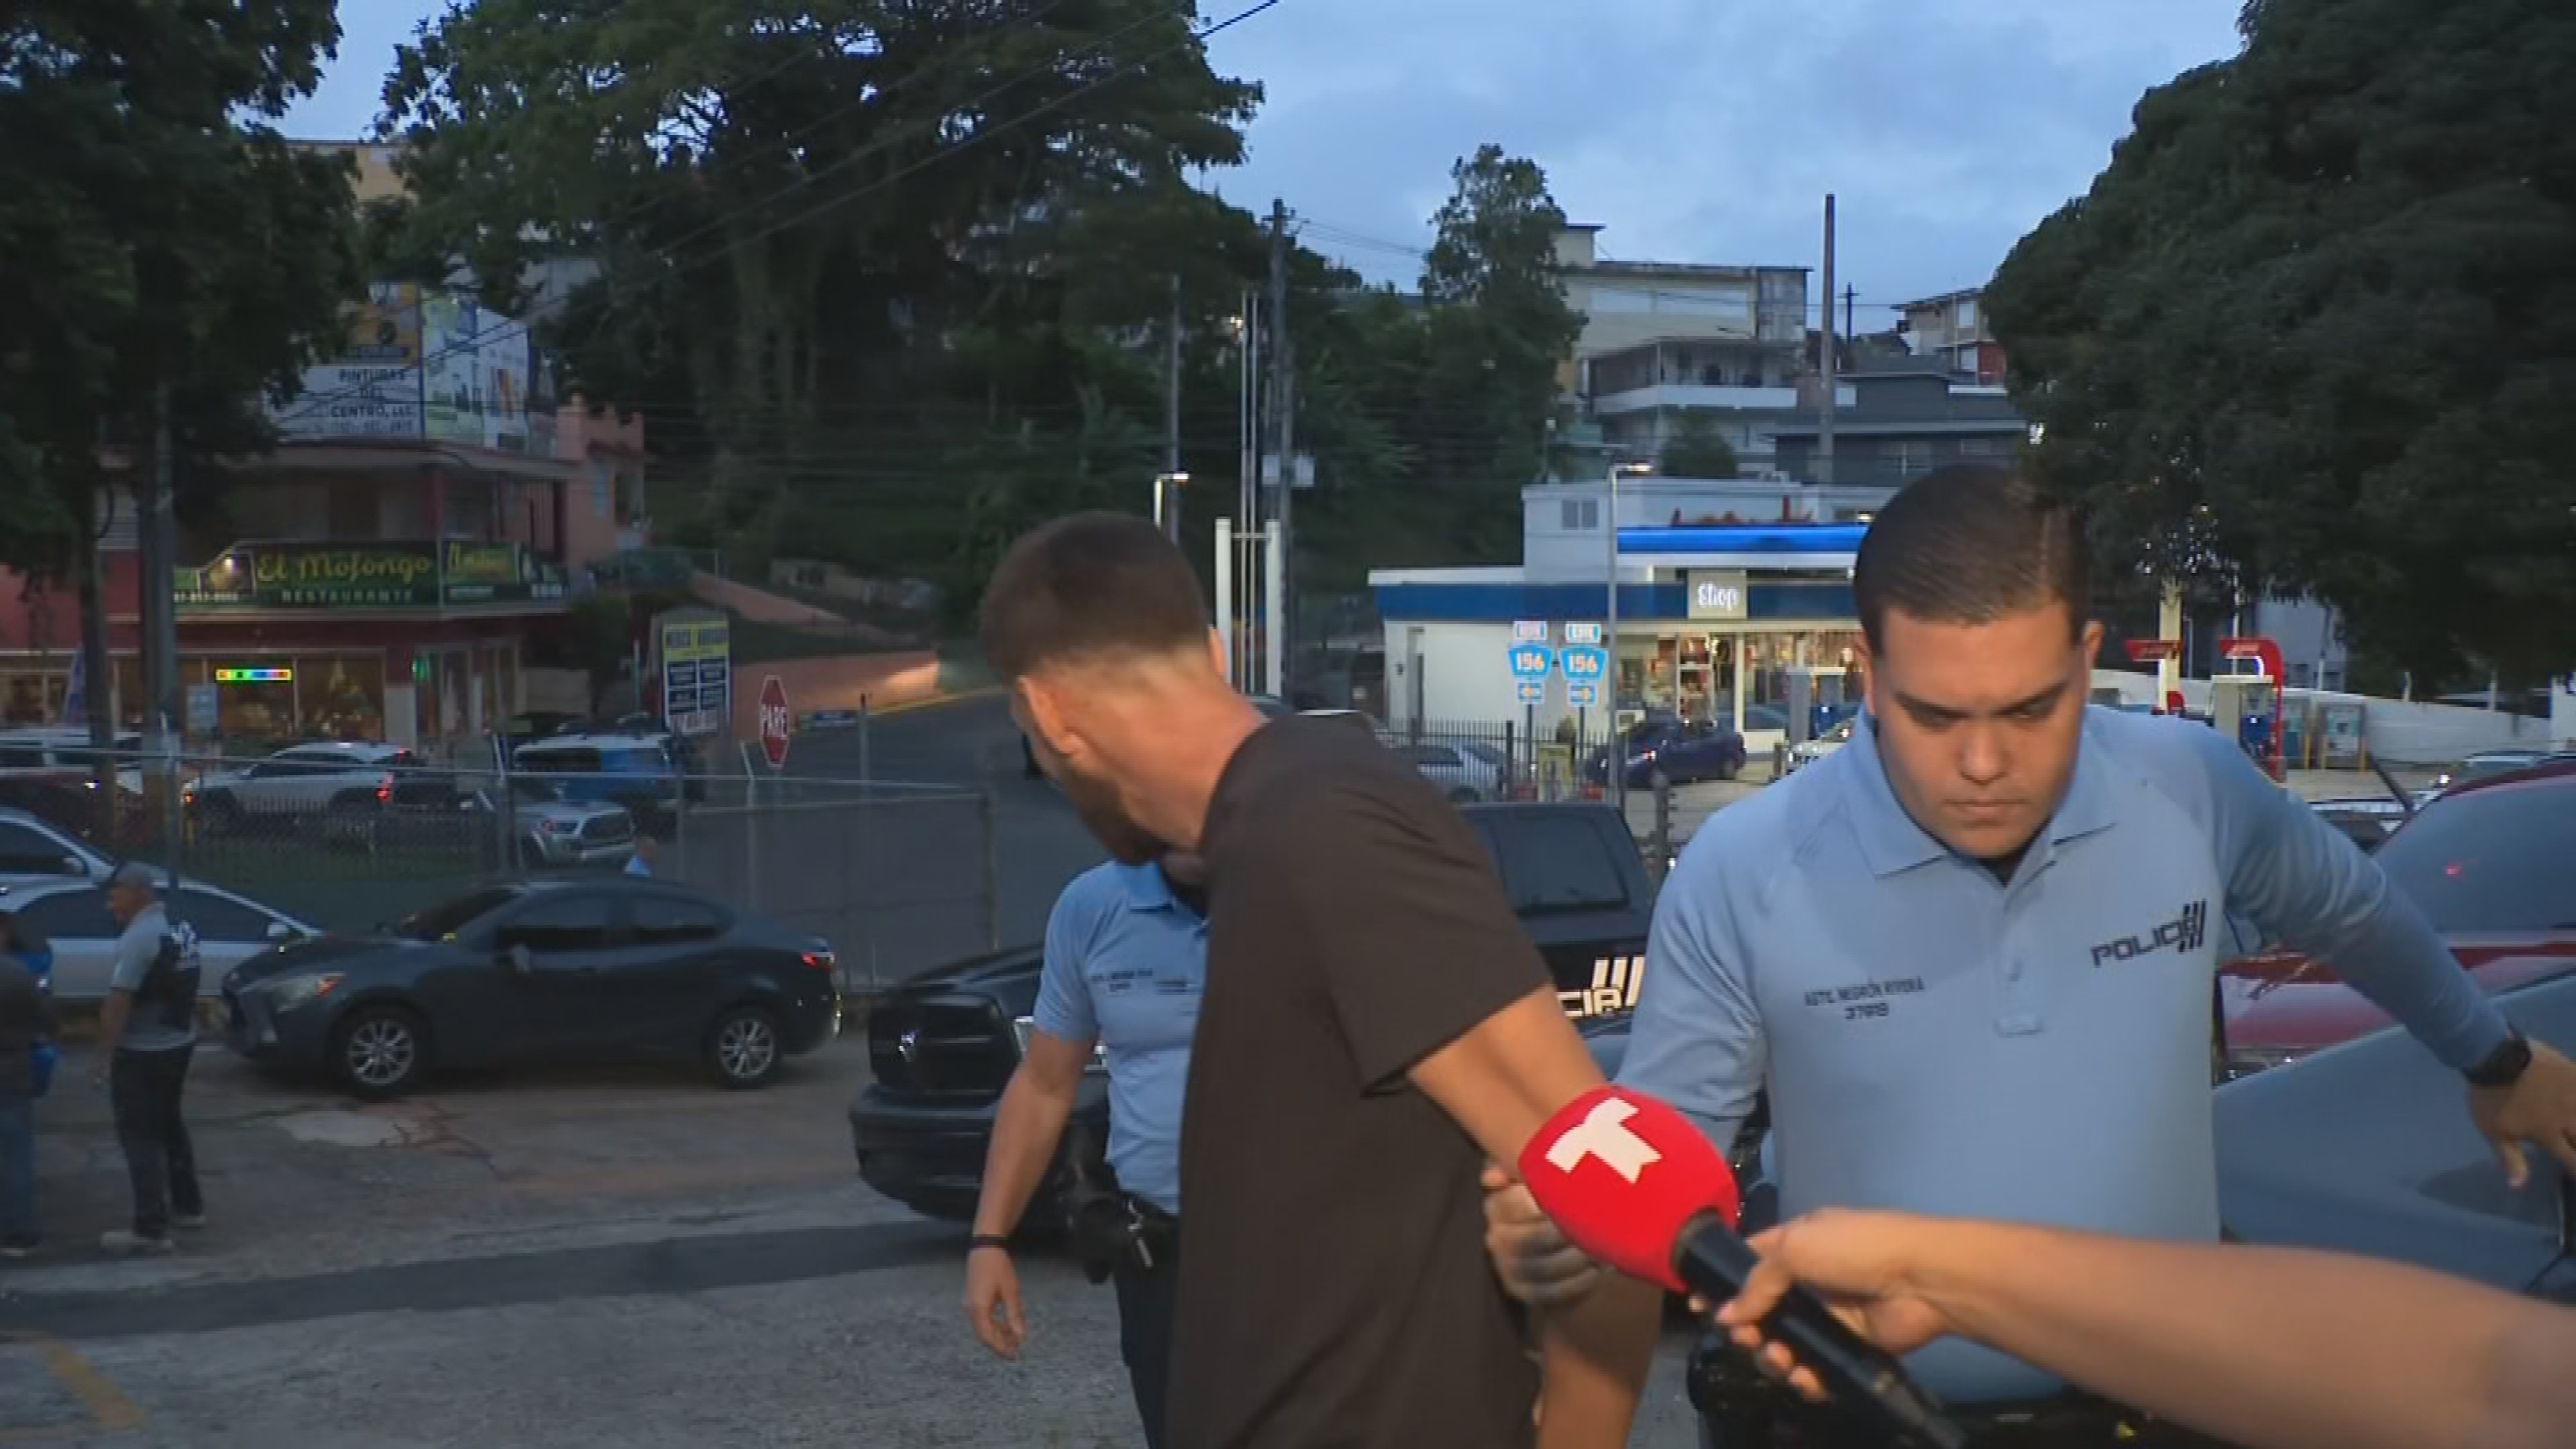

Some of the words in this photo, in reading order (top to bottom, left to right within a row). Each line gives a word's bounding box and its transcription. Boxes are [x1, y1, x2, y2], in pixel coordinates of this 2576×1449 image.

[258, 552, 288, 583] El
[300, 551, 433, 585] Mofongo
[281, 588, 413, 604] RESTAURANTE
[1516, 653, 1545, 670] 156
[1568, 655, 1598, 673] 156
[761, 704, 788, 741] PARE
